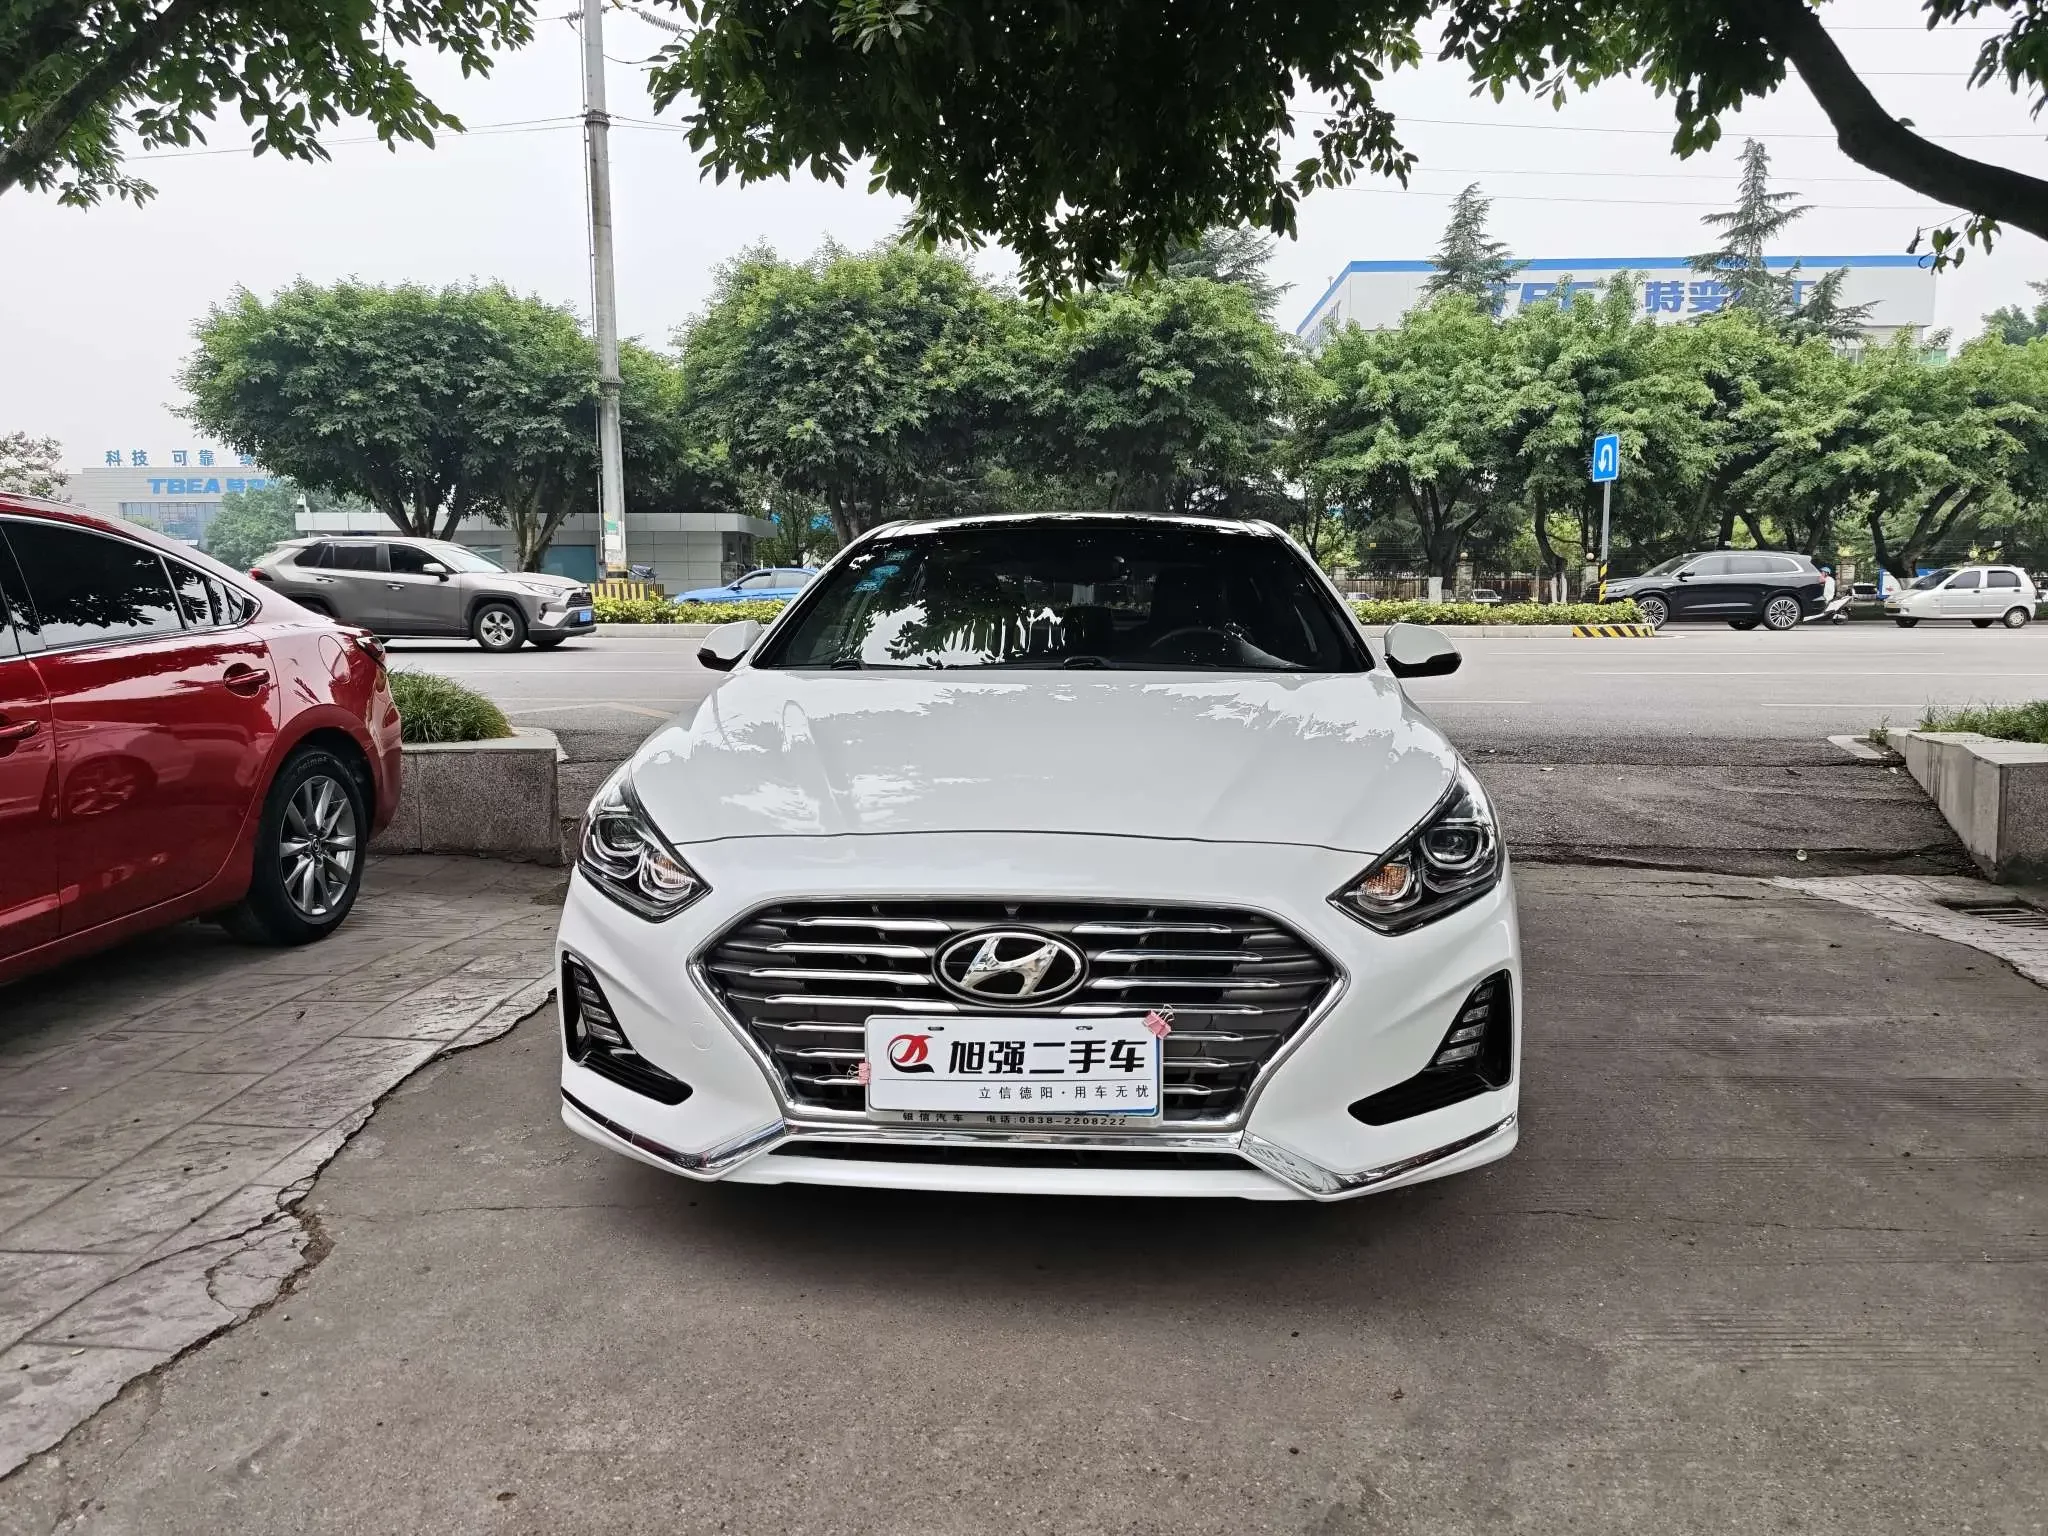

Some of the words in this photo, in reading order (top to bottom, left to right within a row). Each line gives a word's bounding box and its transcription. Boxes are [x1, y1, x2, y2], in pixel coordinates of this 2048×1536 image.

[105, 449, 149, 466] 科技
[171, 449, 214, 466] 可靠
[147, 478, 221, 494] TBEA
[949, 1039, 1147, 1074] 旭强二手车
[978, 1084, 1150, 1100] 立信德阳·用车无忧
[902, 1111, 965, 1123] 银信汽车
